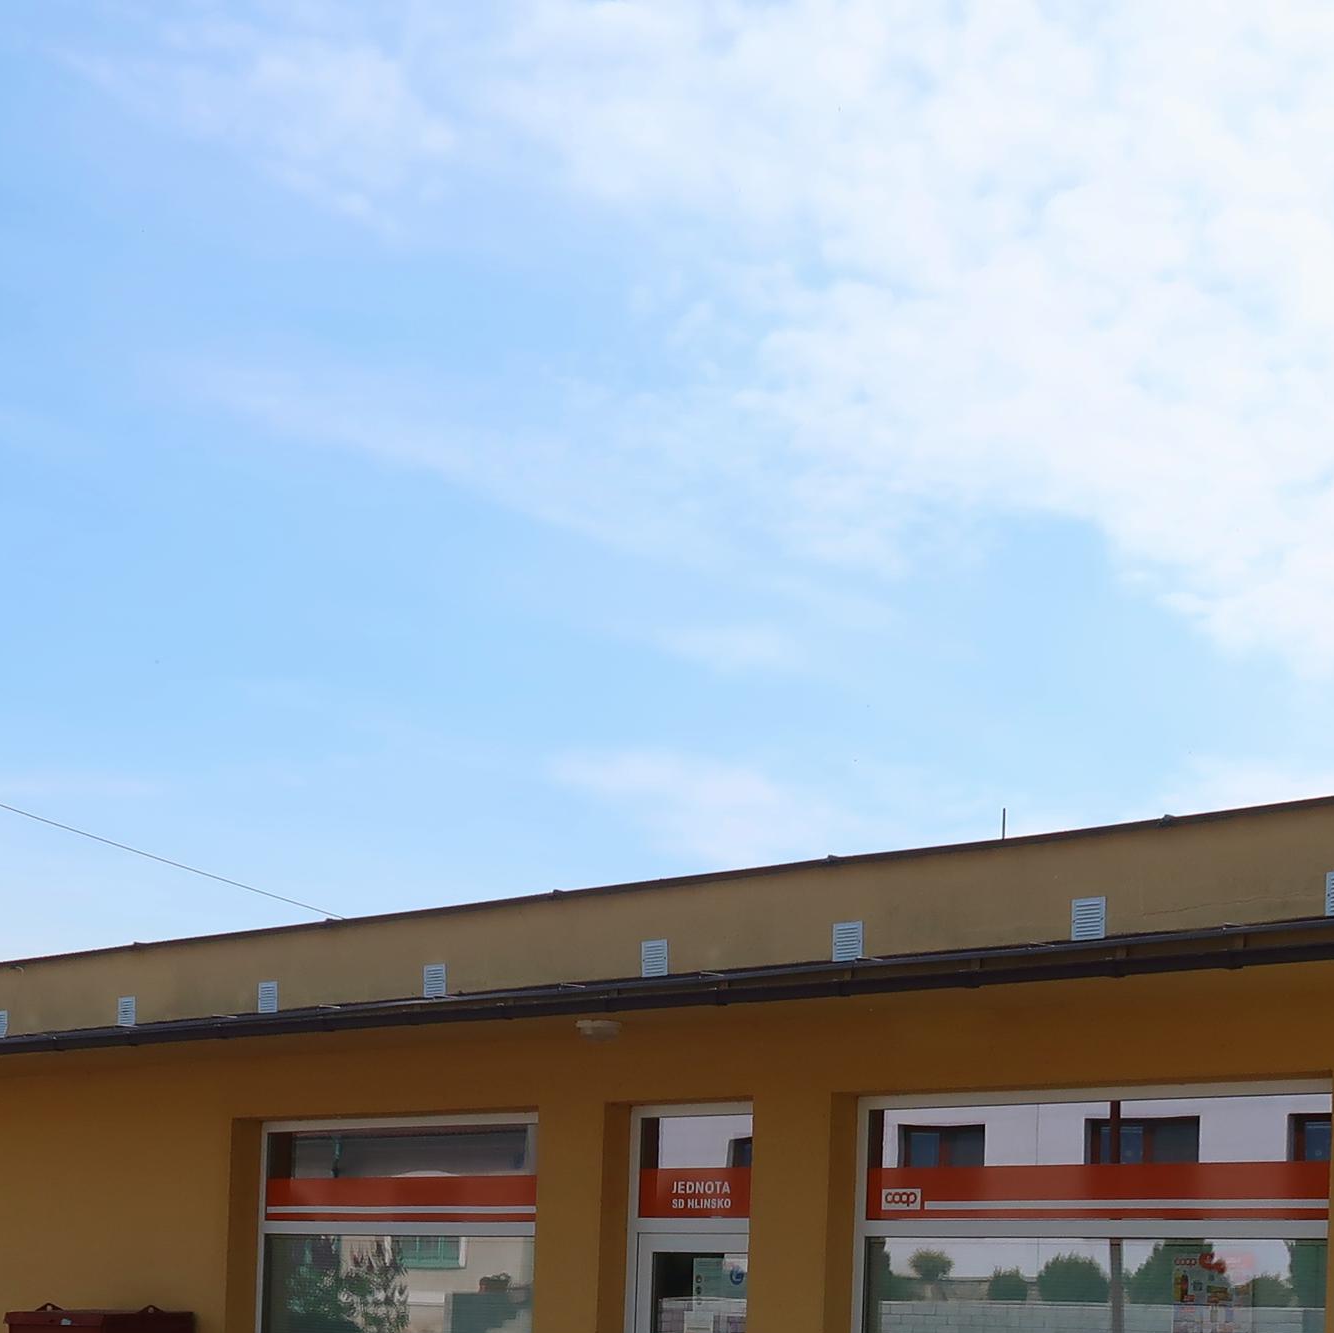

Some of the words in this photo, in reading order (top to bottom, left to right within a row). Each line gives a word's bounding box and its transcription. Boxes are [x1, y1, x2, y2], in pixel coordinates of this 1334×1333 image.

[672, 1181, 731, 1194] JEDNOTA
[672, 1198, 685, 1209] SD
[687, 1198, 732, 1209] HLINSKO
[885, 1191, 918, 1208] coop
